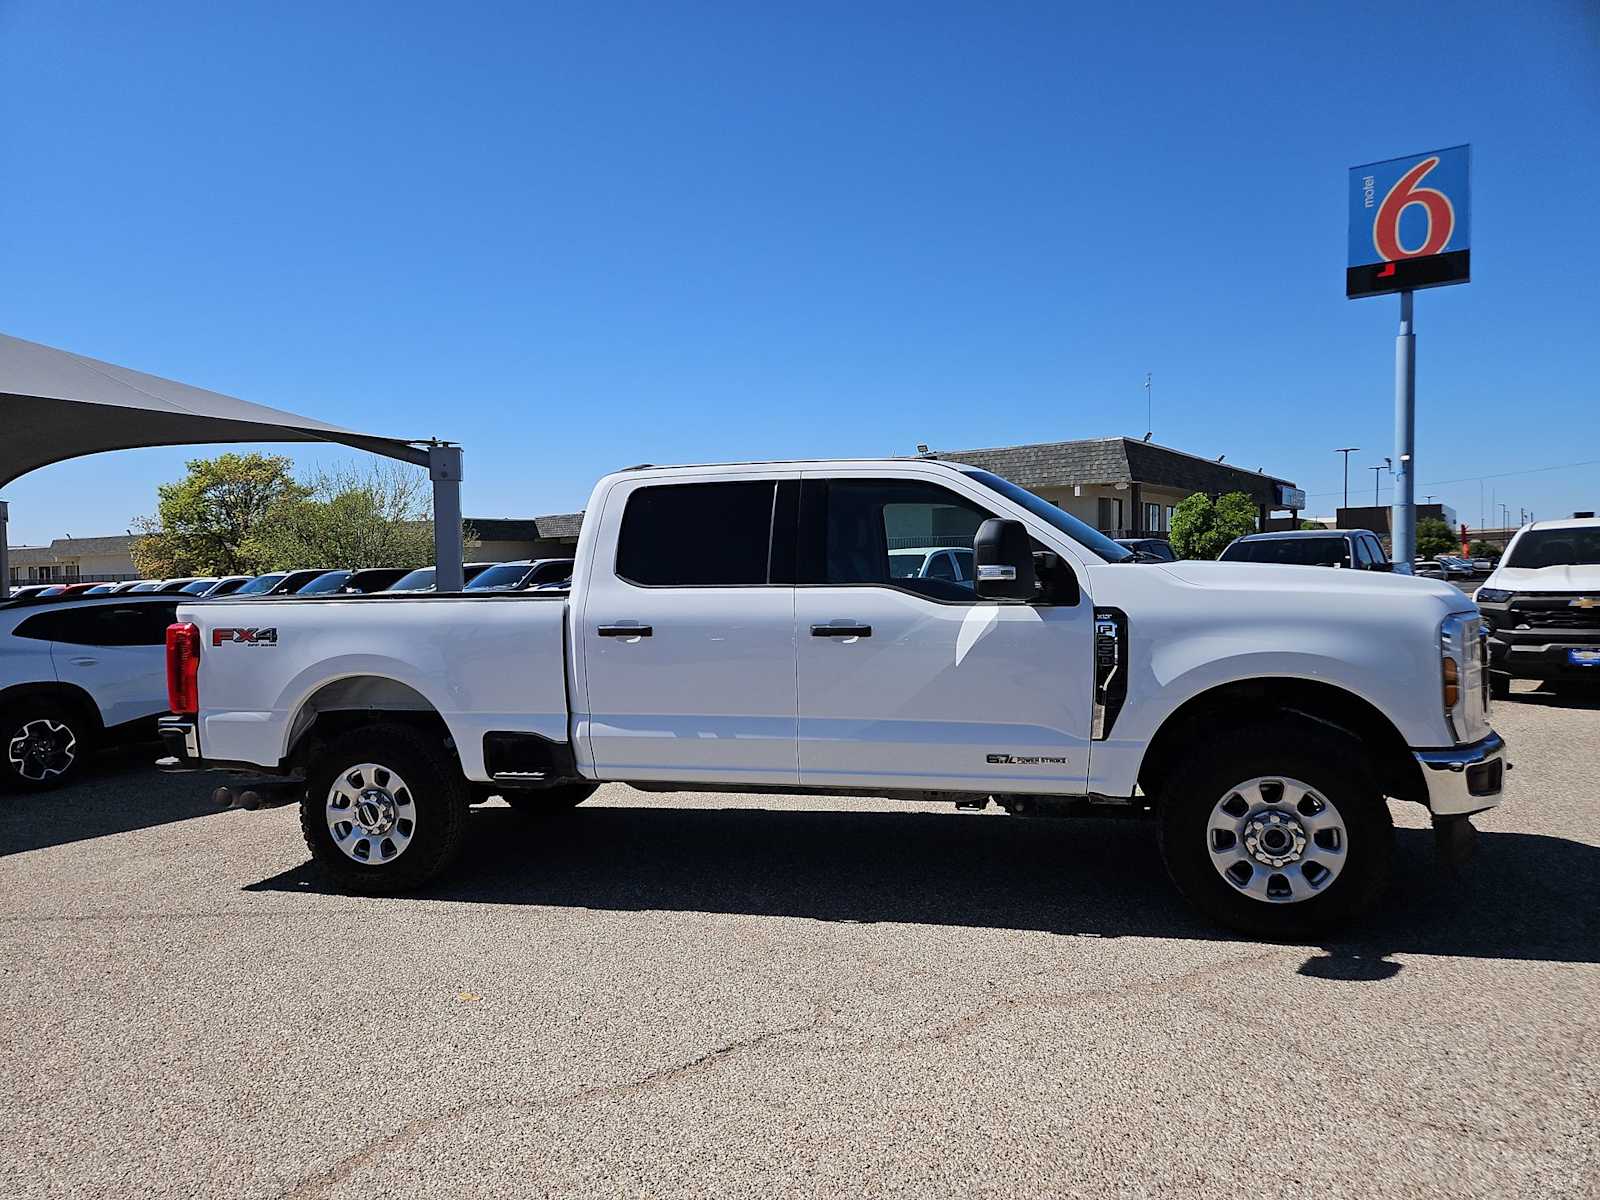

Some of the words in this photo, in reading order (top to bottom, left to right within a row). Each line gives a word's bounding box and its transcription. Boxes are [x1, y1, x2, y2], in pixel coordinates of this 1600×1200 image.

[1363, 175, 1376, 208] motel
[1373, 156, 1455, 262] 6
[212, 628, 278, 647] FX4
